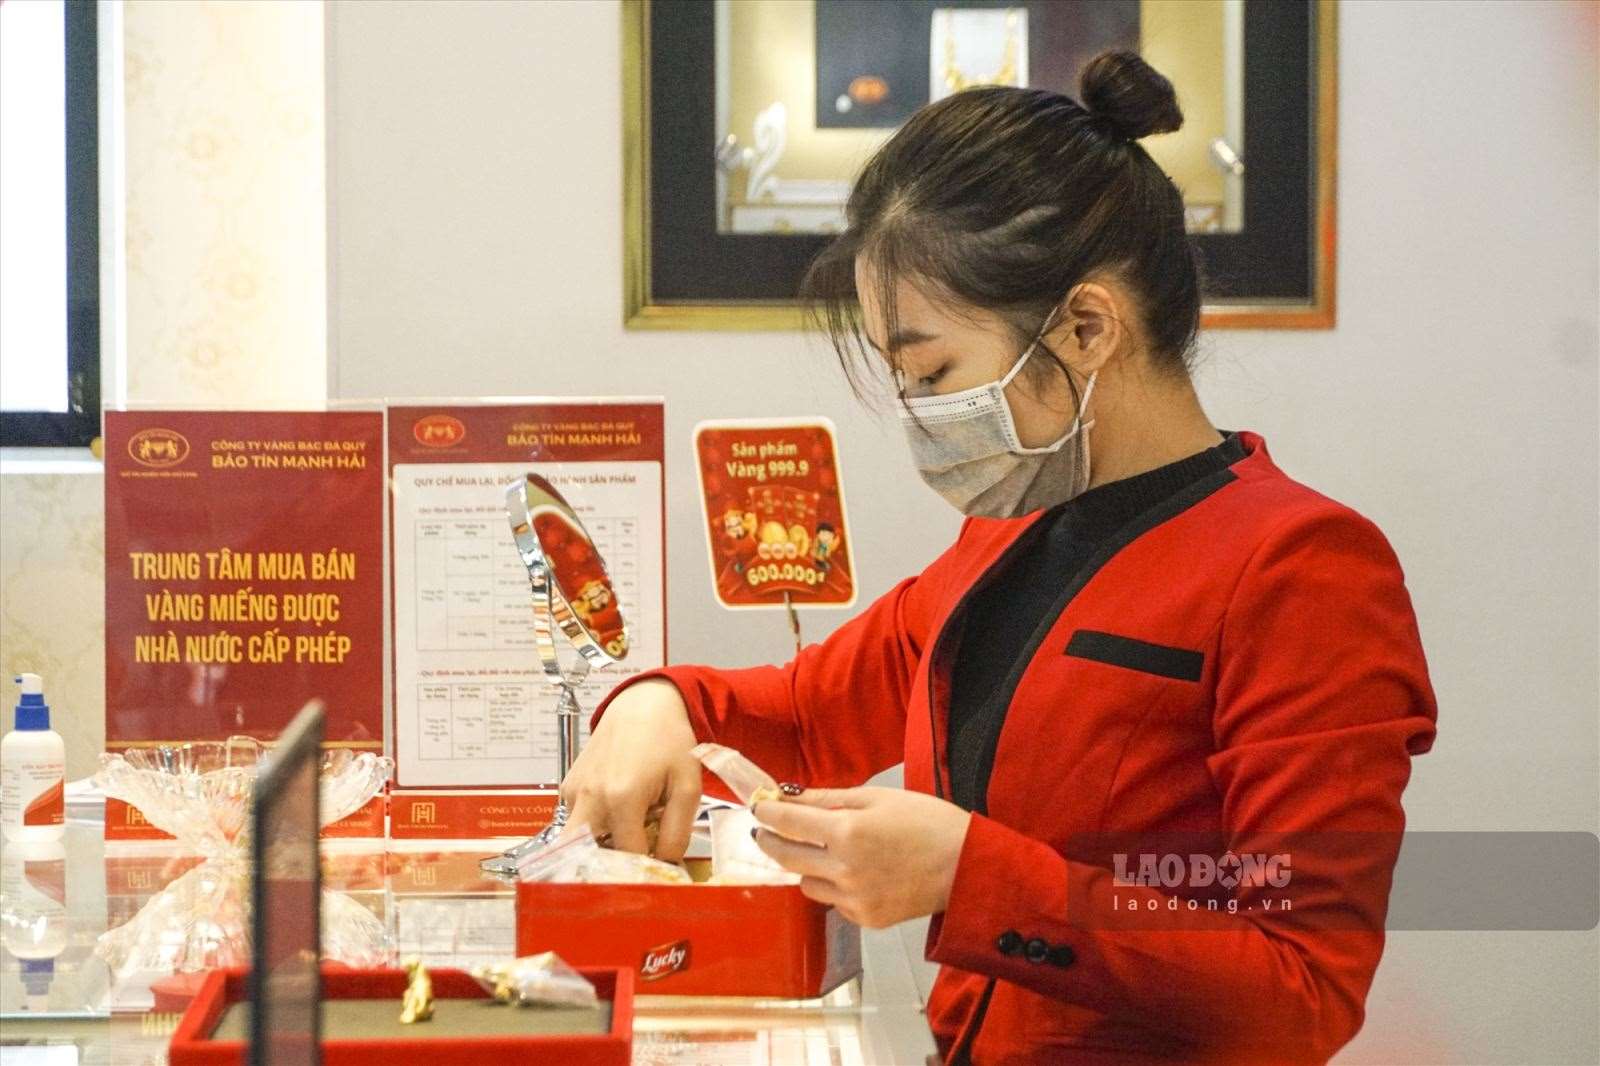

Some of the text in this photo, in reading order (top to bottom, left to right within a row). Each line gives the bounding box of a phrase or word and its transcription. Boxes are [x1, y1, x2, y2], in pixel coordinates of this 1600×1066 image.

[211, 439, 245, 451] CÔNG
[247, 440, 261, 451] TY
[731, 442, 756, 457] Sản
[212, 452, 249, 468] BẢO
[282, 454, 334, 471] MẠNH
[337, 452, 366, 468] HẢI
[726, 460, 809, 481] Vàng 999.9
[414, 478, 433, 488] QUY
[456, 477, 478, 486] MUA
[129, 547, 356, 580] TRUNG TÂM MUA BÁN
[146, 587, 340, 627] VÀNG MIẾNG ĐƯỢC
[135, 628, 351, 663] NHÀ NƯỚC CẤP PHÉP
[641, 947, 686, 974] Lucky
